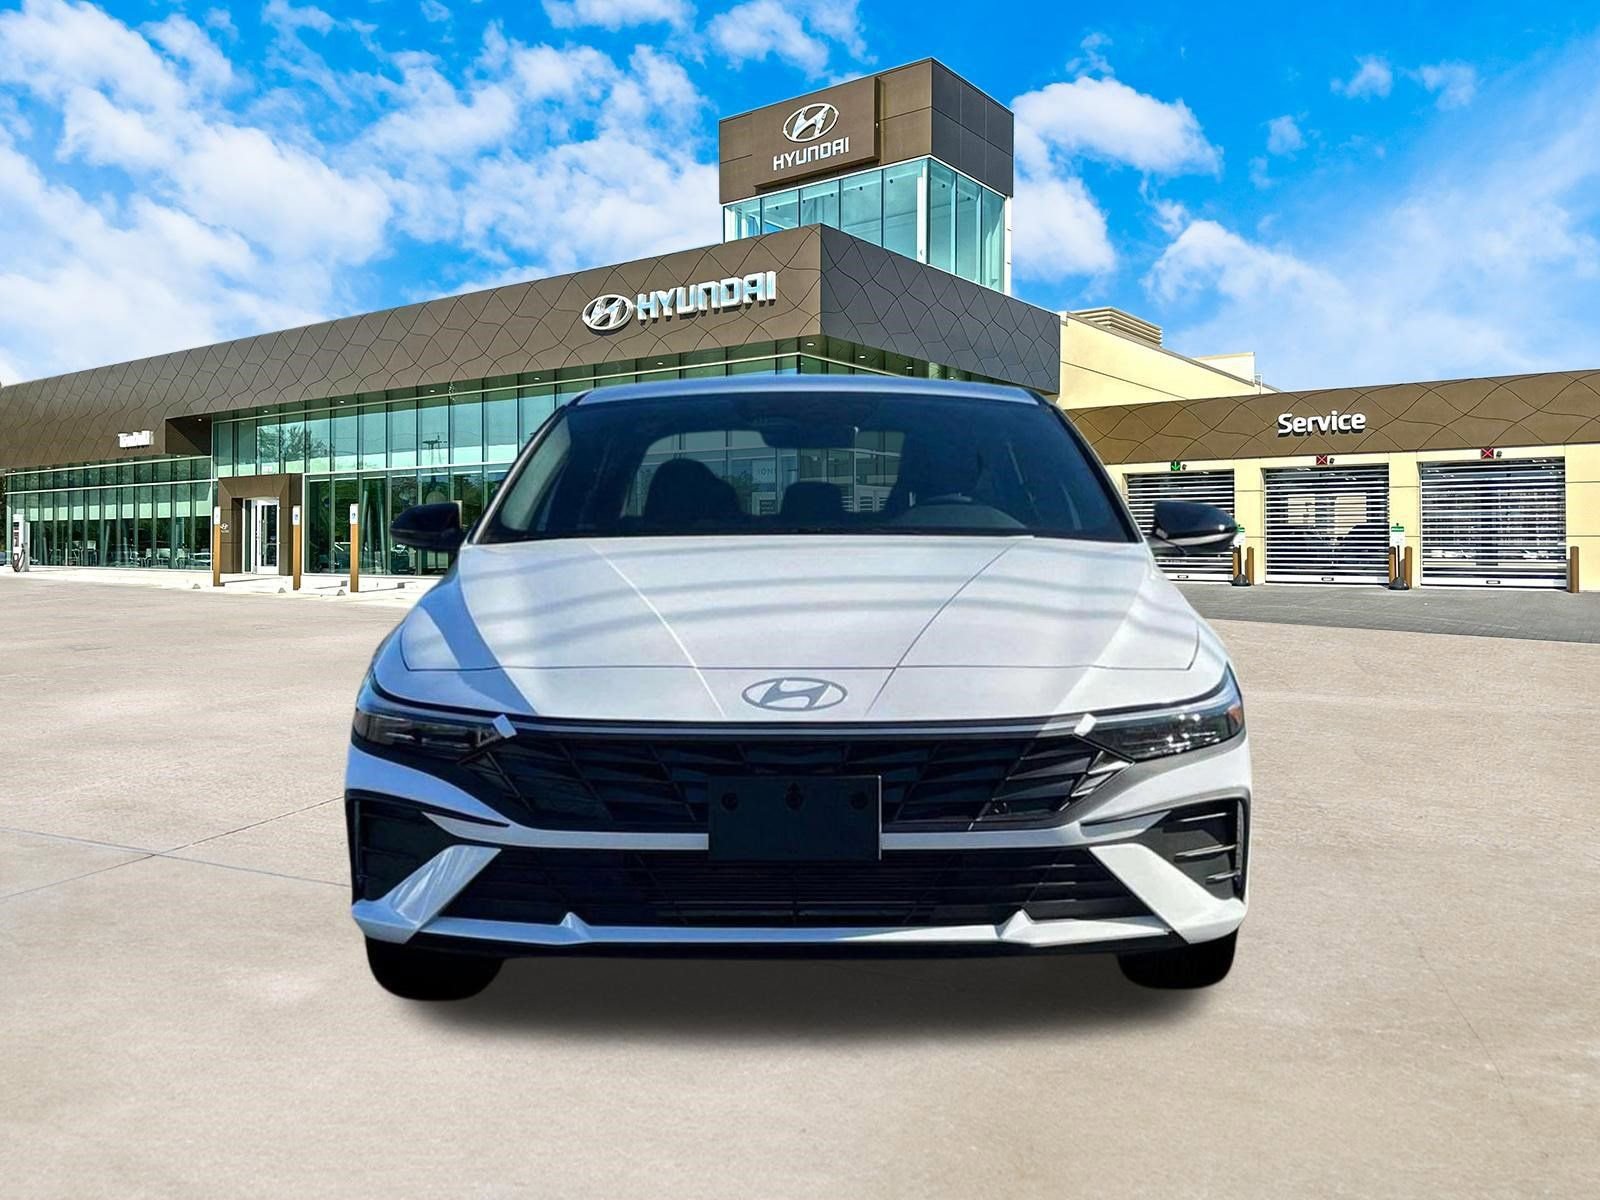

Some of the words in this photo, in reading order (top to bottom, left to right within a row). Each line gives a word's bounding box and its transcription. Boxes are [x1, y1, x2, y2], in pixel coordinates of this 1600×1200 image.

[773, 137, 850, 171] HYUNDAI
[637, 271, 777, 321] HYUNDAI
[1277, 410, 1366, 434] Service
